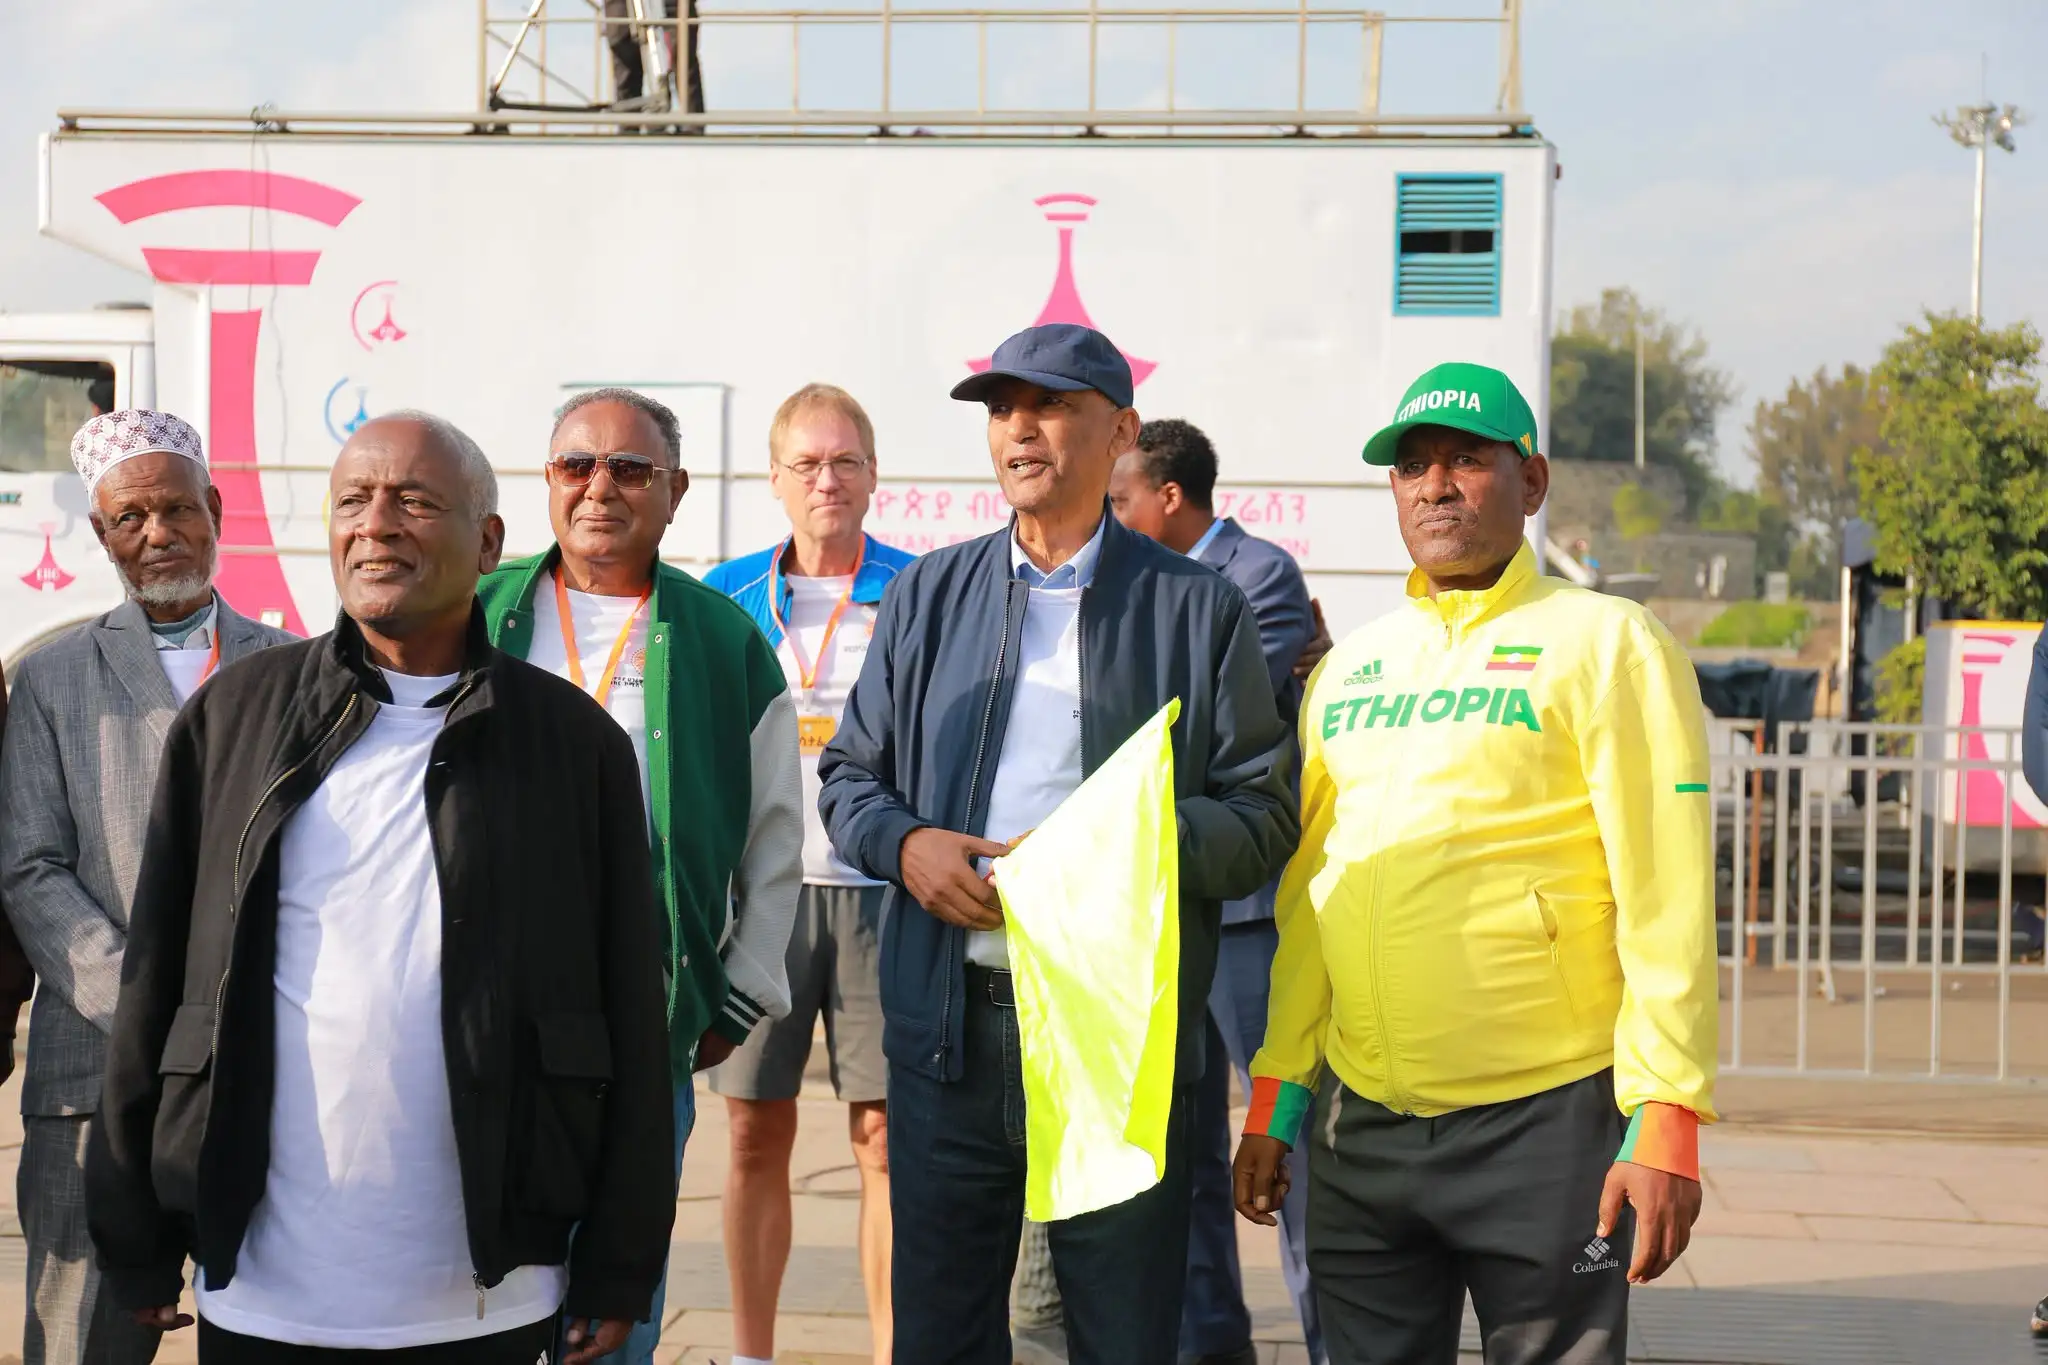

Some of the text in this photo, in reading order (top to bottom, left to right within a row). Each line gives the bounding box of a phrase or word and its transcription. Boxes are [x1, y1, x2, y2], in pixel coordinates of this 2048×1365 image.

[875, 485, 953, 519] ዮጵያ
[1216, 491, 1307, 524] ፖሬሽን
[1322, 687, 1543, 741] ETHIOPIA
[1572, 1258, 1620, 1274] Columbia
